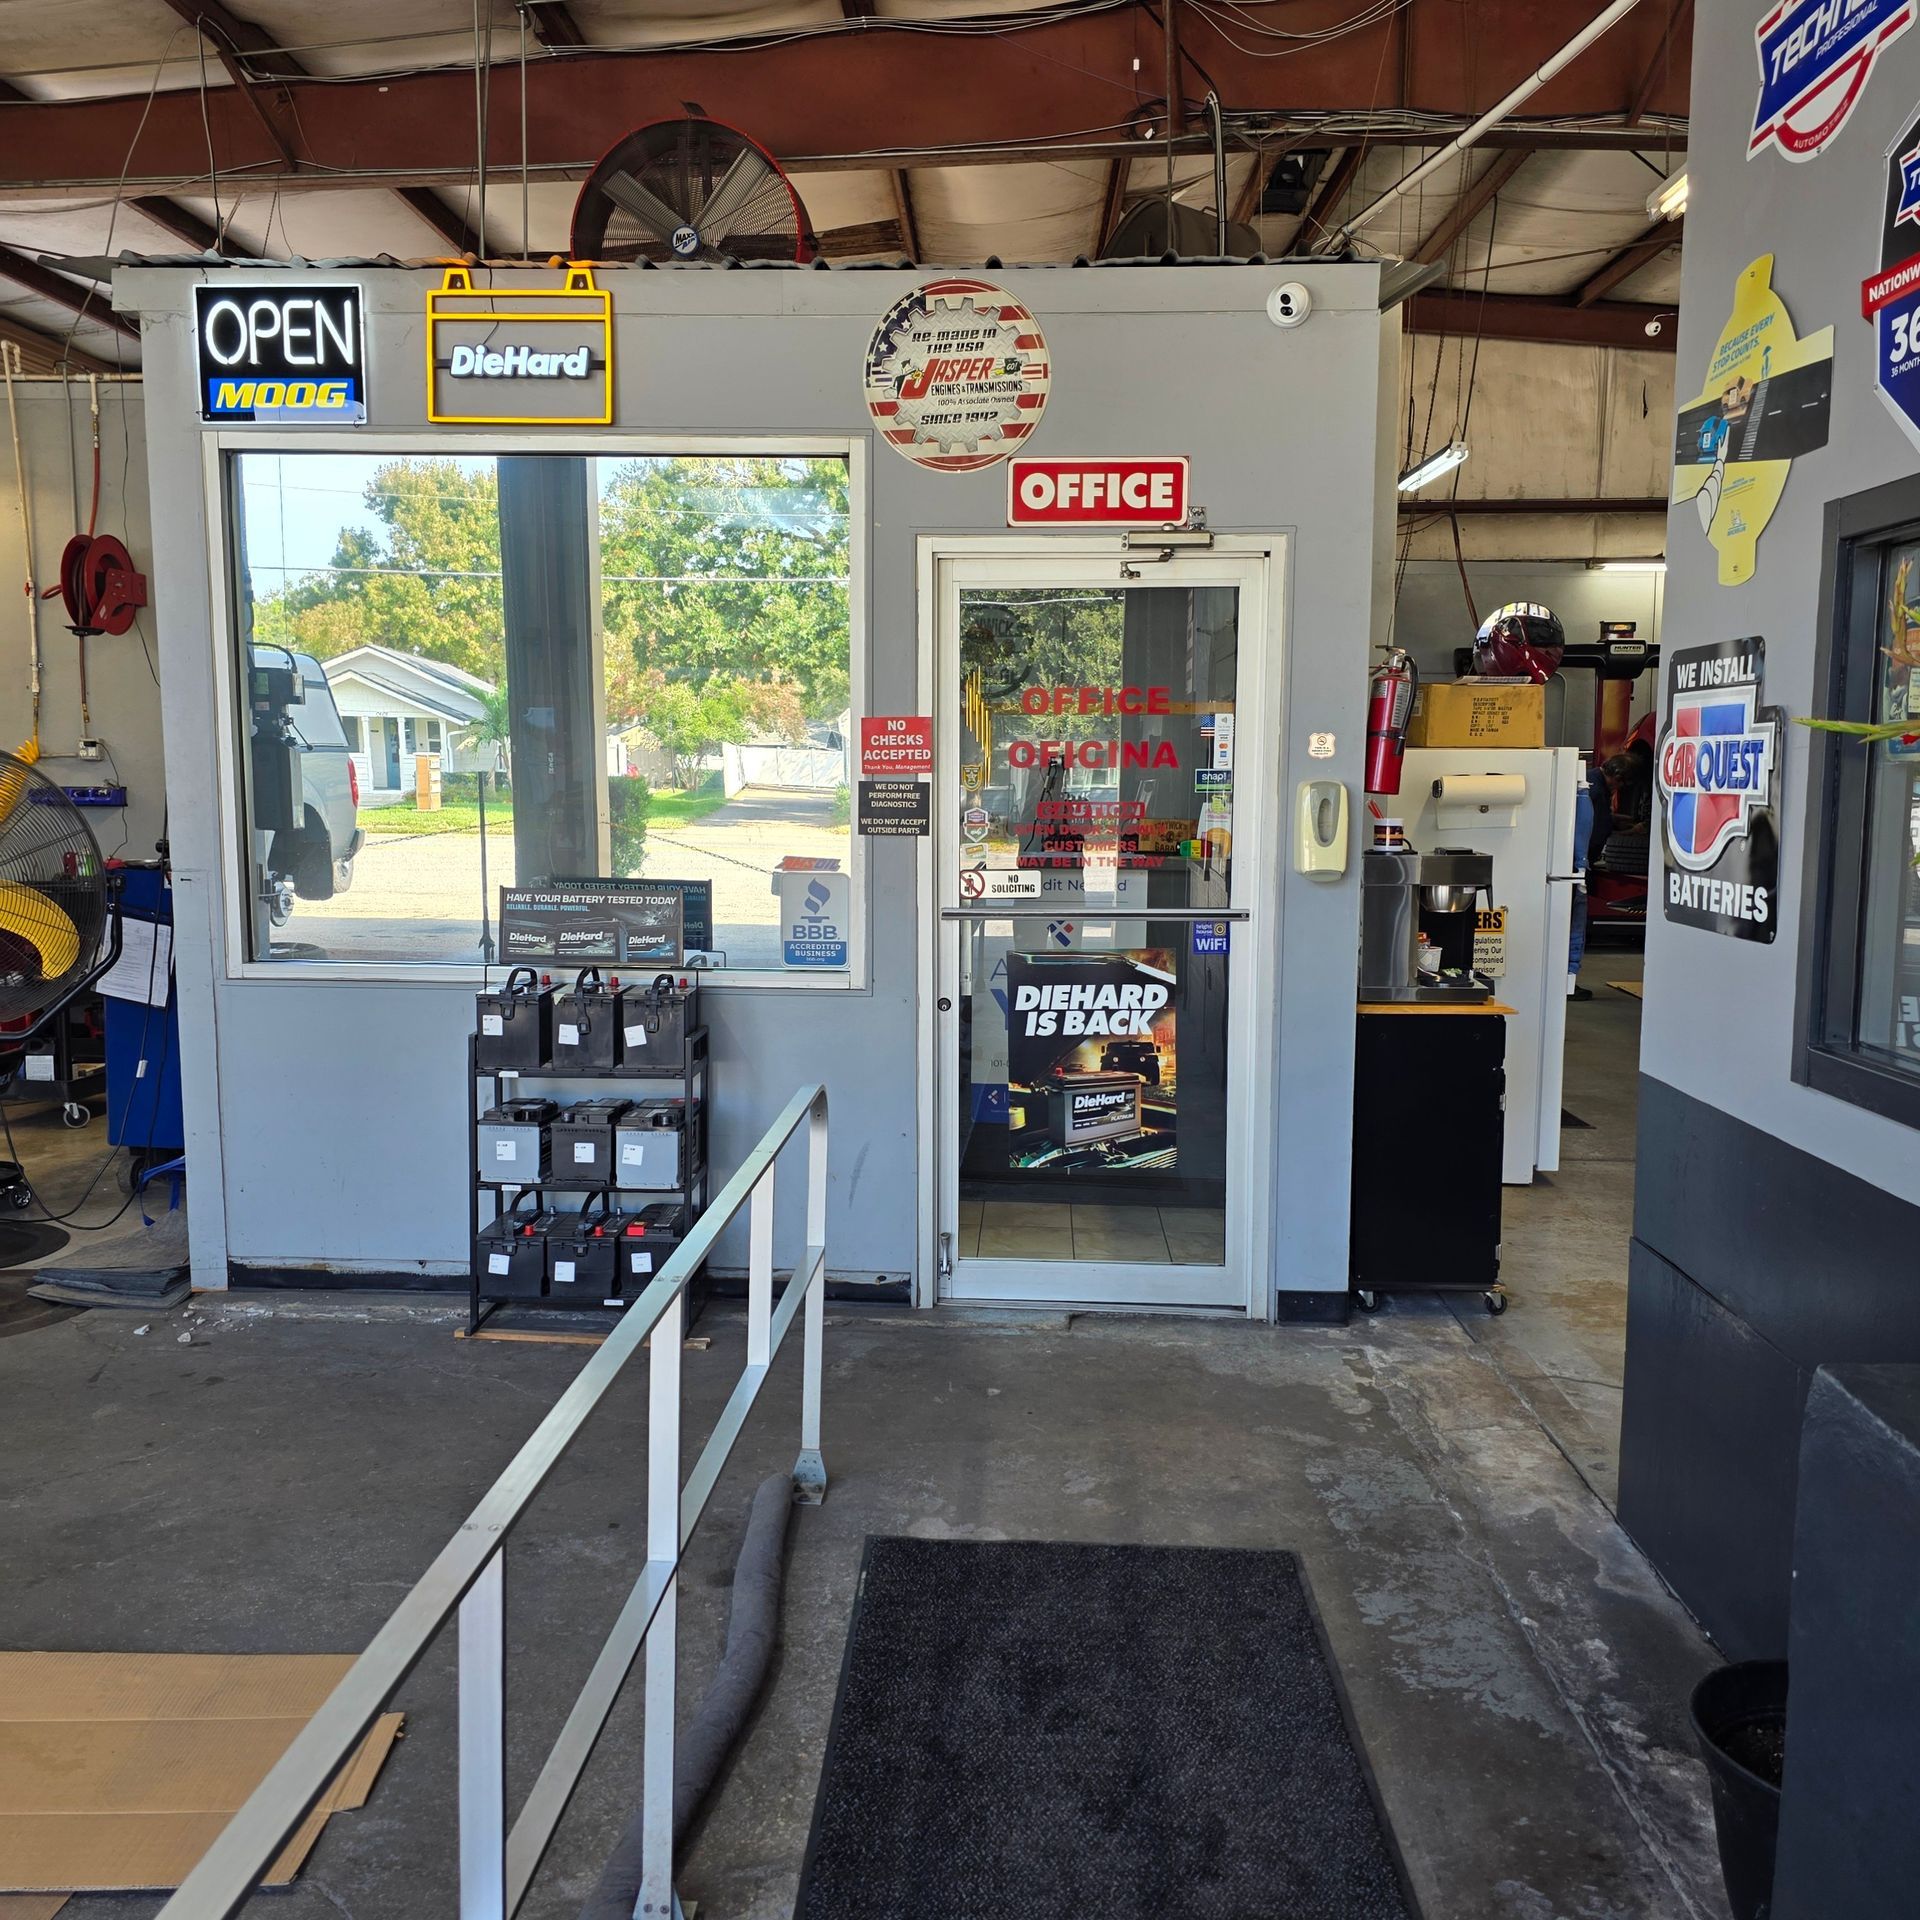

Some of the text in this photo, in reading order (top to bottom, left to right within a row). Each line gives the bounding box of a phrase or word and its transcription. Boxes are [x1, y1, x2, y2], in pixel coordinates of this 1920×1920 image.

[1816, 0, 1878, 59] PROFESSIONAL
[205, 299, 354, 365] OPEN
[1720, 312, 1776, 355] BECAUSE EVERY
[956, 341, 985, 352] USA
[451, 345, 590, 378] DieHard
[1712, 354, 1730, 374] STOP
[900, 357, 996, 399] JASPER
[931, 383, 961, 396] ENGINES
[966, 380, 1023, 395] TRANSMISSIONS
[215, 382, 348, 409] MOOG
[958, 397, 990, 405] Associate
[991, 396, 1015, 404] Owned
[965, 410, 999, 423] 1942
[1020, 472, 1174, 510] OFFICE
[1676, 654, 1756, 690] WE INSTALL
[1022, 686, 1171, 716] OFFICE
[887, 720, 906, 731] NO
[870, 734, 924, 746] CHECKS
[863, 749, 931, 760] ACCEPTED
[1008, 740, 1179, 769] OFICINA
[1662, 738, 1764, 792] CARQUEST
[1201, 772, 1227, 782] snap!
[875, 783, 914, 791] WE DO NOT
[1041, 803, 1142, 817] CAUTION
[900, 818, 927, 826] ACCEPT
[1014, 824, 1055, 835] OPEN
[1059, 824, 1101, 835] DOOR
[1043, 840, 1137, 851] CUSTOMERS
[1017, 856, 1166, 867] MAY BE IN THE WAY
[1007, 874, 1019, 883] NO
[991, 884, 1035, 893] SOLICITING
[506, 893, 532, 902] HAVE
[534, 894, 560, 903] YOUR
[562, 894, 605, 904] BATTERY
[607, 896, 643, 905] TESTED
[644, 896, 677, 905] TODAY
[1668, 871, 1769, 924] BATTERIES
[560, 904, 590, 912] POWERFUL.
[509, 932, 547, 943] DieHard
[560, 931, 604, 942] DieHard
[792, 925, 838, 940] BBB
[628, 934, 665, 945] DieHard
[1195, 937, 1227, 950] WiFi
[1490, 946, 1502, 954] Our
[1015, 984, 1168, 1011] DIEHARD
[1024, 1011, 1057, 1036] IS
[1063, 1010, 1157, 1036] BACK
[1074, 1091, 1126, 1109] DieHard
[1110, 1113, 1134, 1122] PLATINUM
